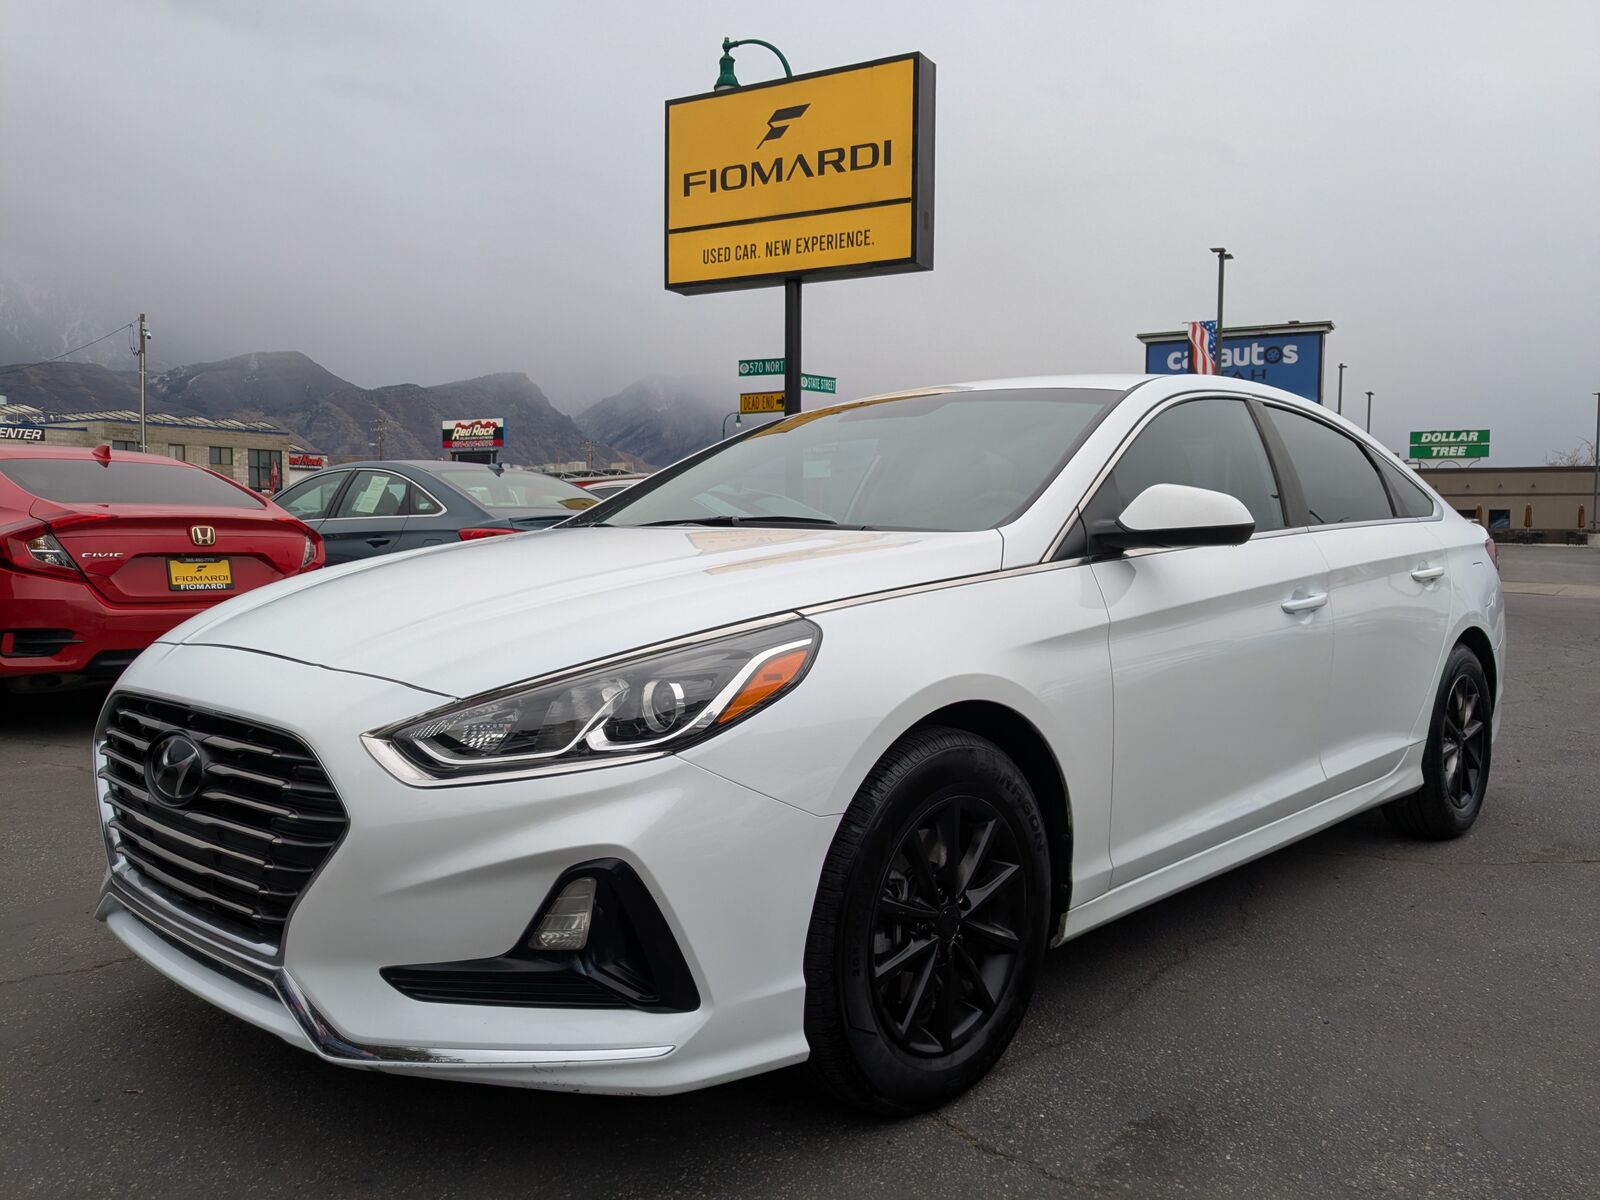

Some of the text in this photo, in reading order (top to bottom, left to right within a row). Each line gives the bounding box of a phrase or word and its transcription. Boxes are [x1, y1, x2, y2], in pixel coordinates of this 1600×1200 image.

[683, 139, 892, 197] FIOMARDI
[703, 229, 875, 264] USED CAR. NEW EXPERIENCE.
[749, 362, 764, 373] 570
[807, 376, 835, 391] STATE STREET
[743, 395, 775, 410] DEAD END
[452, 425, 496, 440] Red Rock
[1421, 431, 1479, 443] DOLLAR
[1431, 446, 1468, 457] TREE
[174, 574, 230, 582] FIOMARDI
